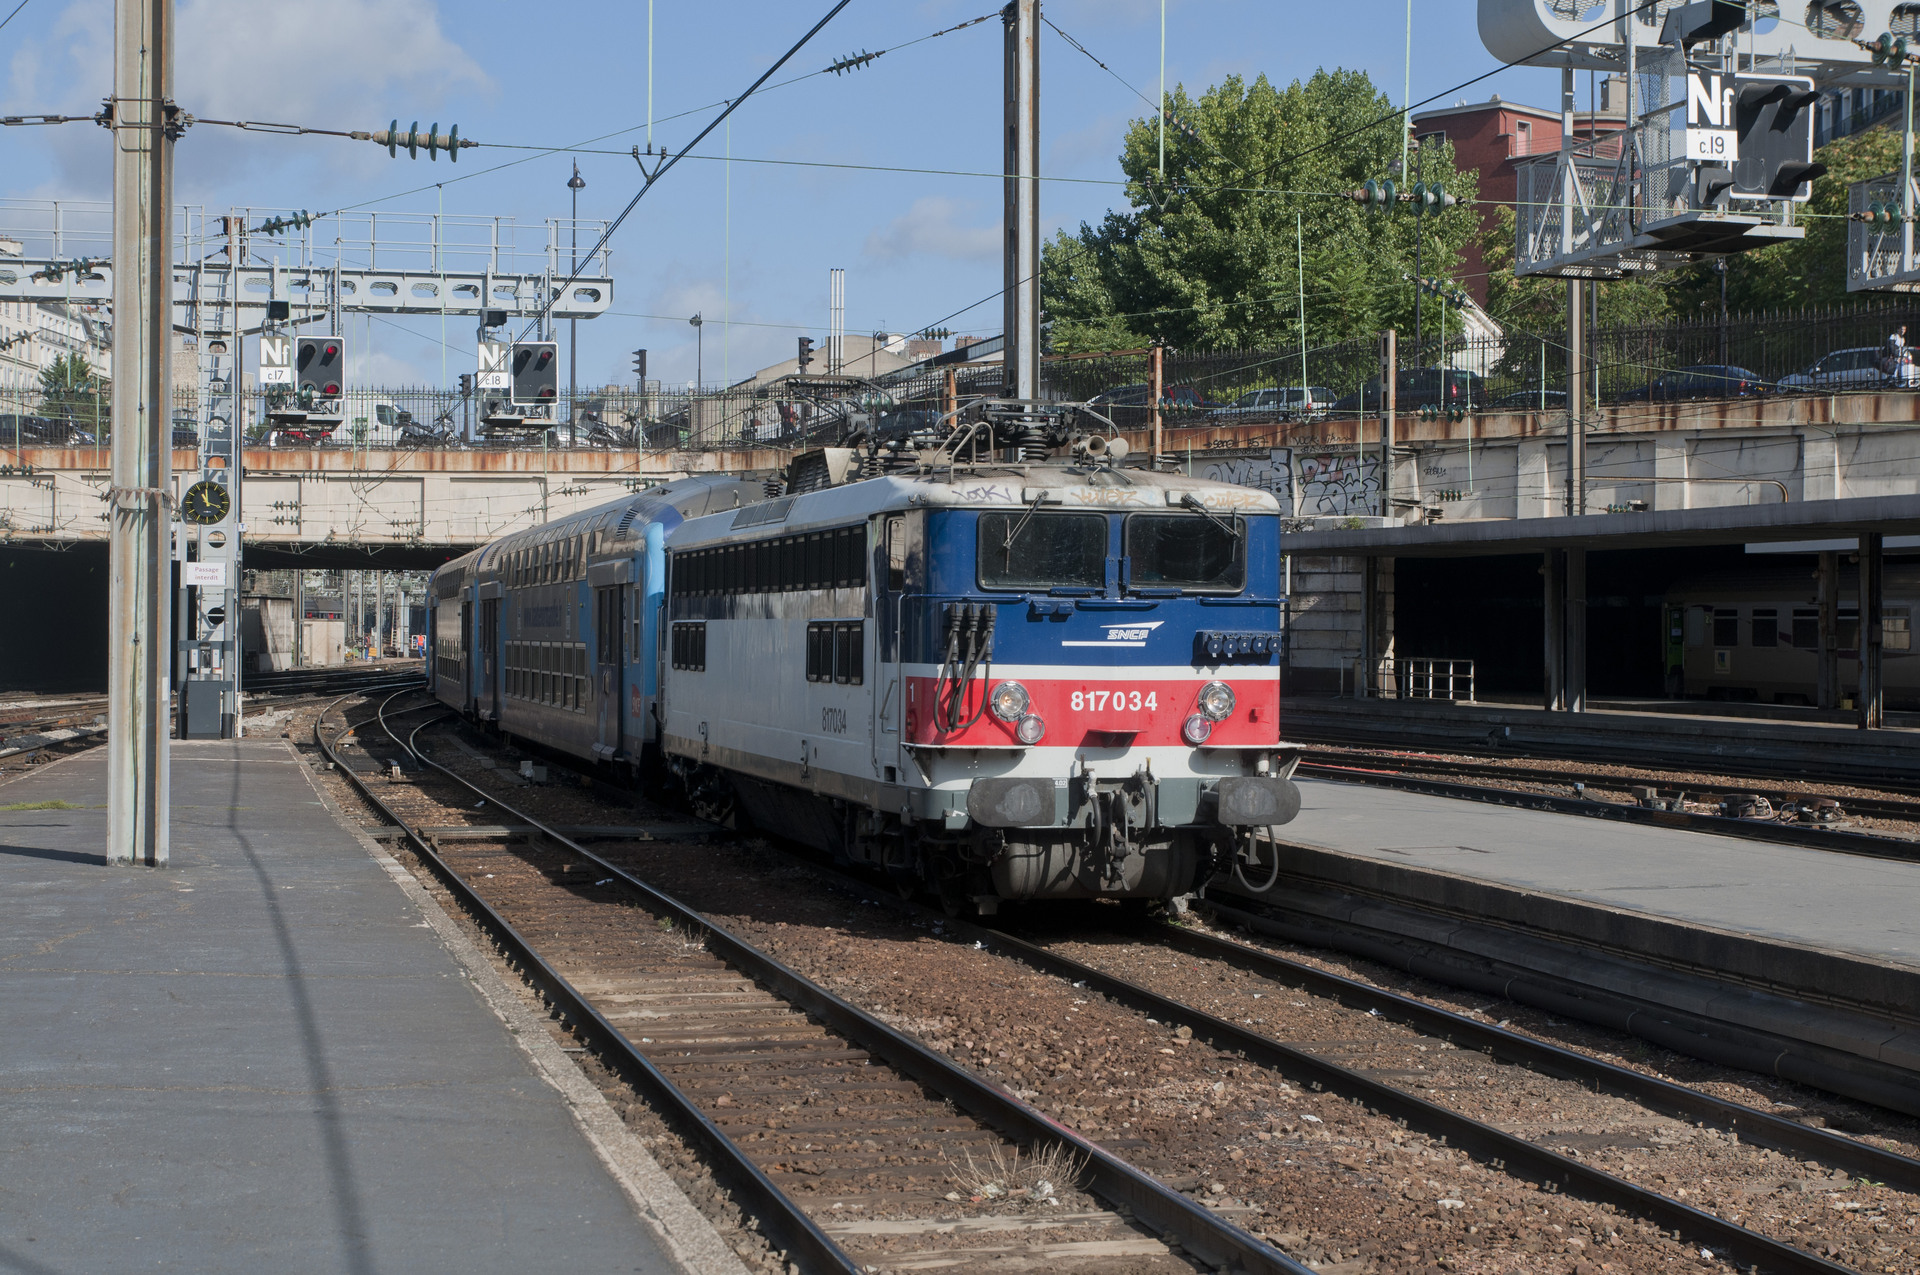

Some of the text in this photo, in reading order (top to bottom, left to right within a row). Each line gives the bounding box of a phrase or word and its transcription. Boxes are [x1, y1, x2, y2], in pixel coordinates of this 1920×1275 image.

[1687, 73, 1735, 126] Nf
[1699, 135, 1725, 154] c.19
[261, 338, 290, 365] Nf
[1107, 629, 1149, 640] SNCF
[1071, 691, 1158, 712] 817034
[822, 706, 847, 735] 817034
